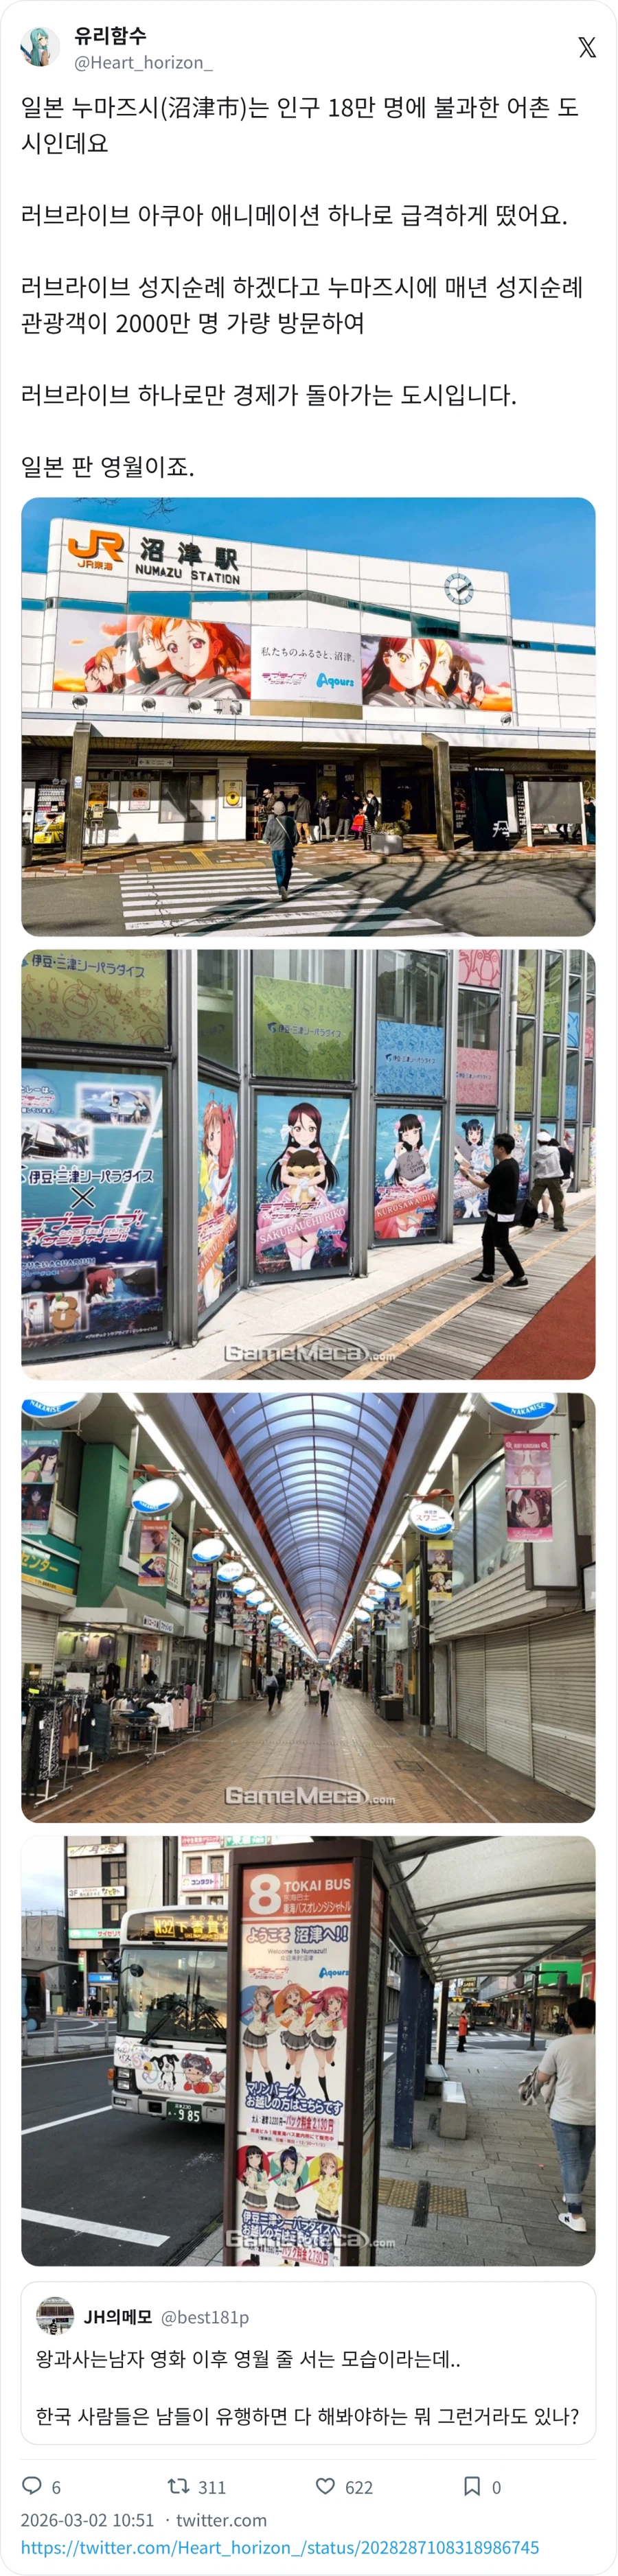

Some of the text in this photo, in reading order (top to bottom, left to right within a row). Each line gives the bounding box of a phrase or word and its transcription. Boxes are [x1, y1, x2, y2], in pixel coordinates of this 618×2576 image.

[68, 530, 124, 562] JR
[140, 537, 239, 571] 沼津駅
[77, 560, 113, 570] JR東海
[135, 564, 240, 585] NUMAZU STATION
[261, 647, 355, 662] 私たちのふるさと、沼津。
[317, 673, 354, 689] Aqours
[376, 1193, 436, 1217] KUROSAWA DIA
[260, 1207, 346, 1244] SAKURAUCHI RIKO
[317, 1228, 342, 1238] Aqours
[30, 1400, 61, 1413] NAKAMISE
[511, 1402, 546, 1415] NAKAMISE
[284, 1878, 351, 1892] TOKAI BUS
[249, 1874, 282, 1915] 8
[283, 1901, 352, 1914] 東海バスオレンジシャトル
[155, 1920, 174, 1934] N32
[247, 1925, 348, 1944] ようこそ 沼津へ!!
[319, 1967, 350, 1978] Aqours
[246, 2081, 306, 2098] マリンパークへ
[245, 2095, 343, 2115] お越しの方はこちらです
